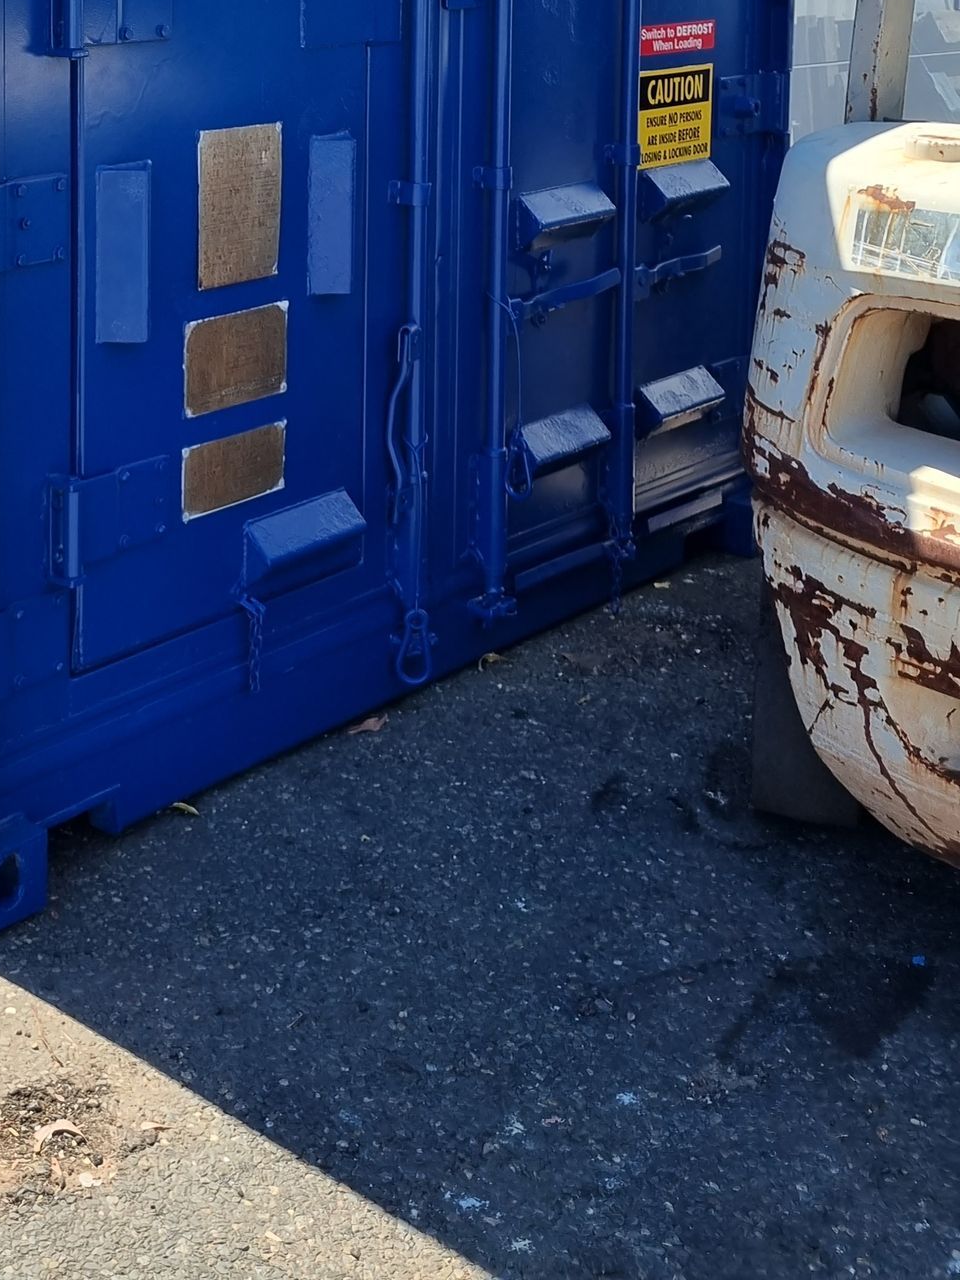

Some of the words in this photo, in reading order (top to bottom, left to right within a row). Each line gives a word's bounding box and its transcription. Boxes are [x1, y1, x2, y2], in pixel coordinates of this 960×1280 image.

[641, 27, 666, 41] Switch
[667, 27, 675, 38] to
[676, 22, 713, 37] DEFROST
[652, 40, 673, 52] When
[674, 37, 702, 50] Loading
[647, 73, 703, 105] CAUTION
[646, 114, 667, 128] ENSURE
[668, 111, 678, 125] NO
[679, 109, 702, 123] PERSONS
[647, 134, 658, 146] ARE
[658, 131, 677, 144] INSIDE
[677, 126, 700, 142] BEFORE
[641, 150, 661, 164] LOSING
[662, 149, 667, 160] &
[668, 145, 692, 160] LOCKING
[692, 142, 708, 155] DOOR
